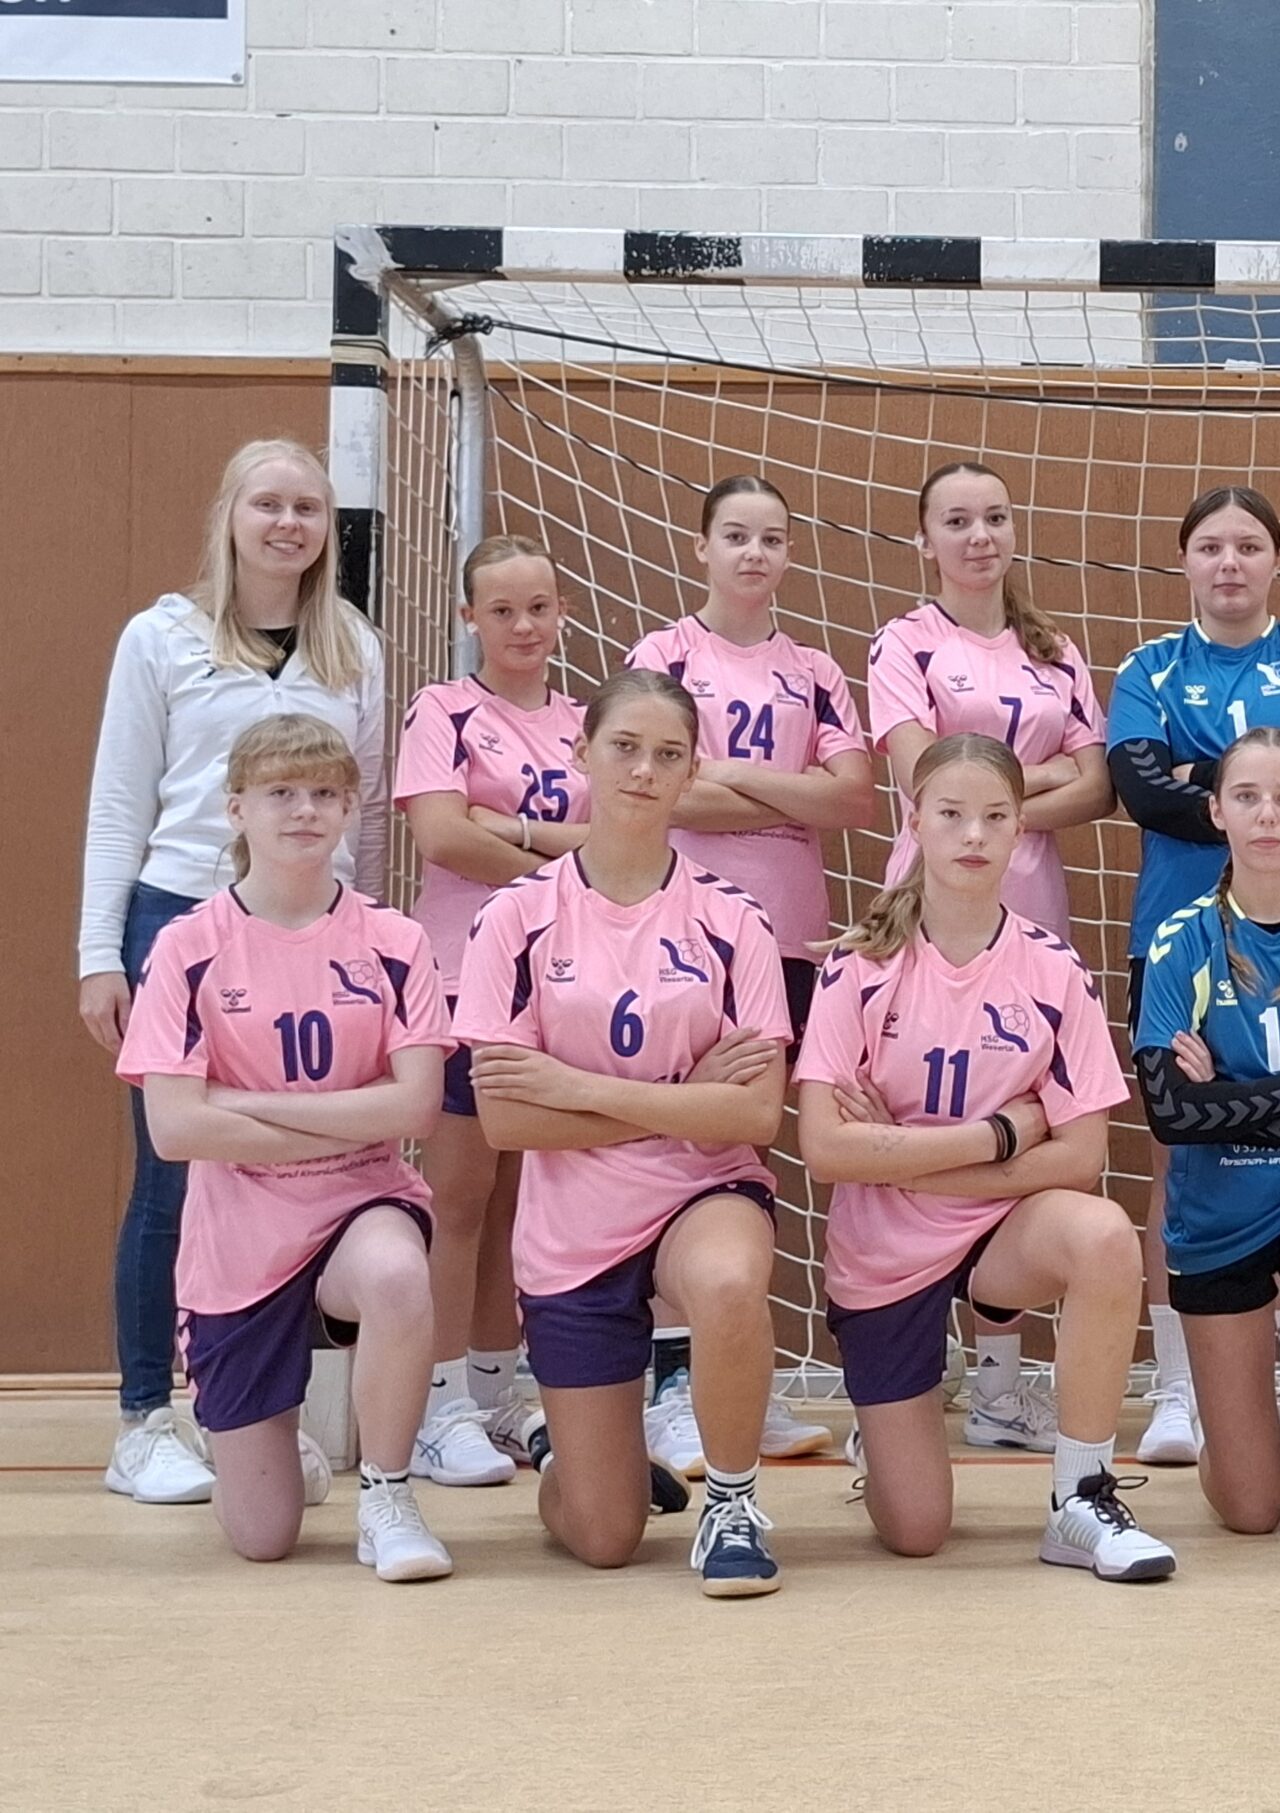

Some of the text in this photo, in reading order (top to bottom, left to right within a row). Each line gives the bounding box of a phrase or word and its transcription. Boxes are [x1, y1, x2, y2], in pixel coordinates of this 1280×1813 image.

[726, 699, 775, 761] 24
[1000, 696, 1023, 750] 7
[1226, 700, 1248, 738] 1
[518, 763, 569, 822] 25
[273, 1010, 333, 1083] 10
[610, 989, 644, 1058] 6
[923, 1047, 970, 1118] 11
